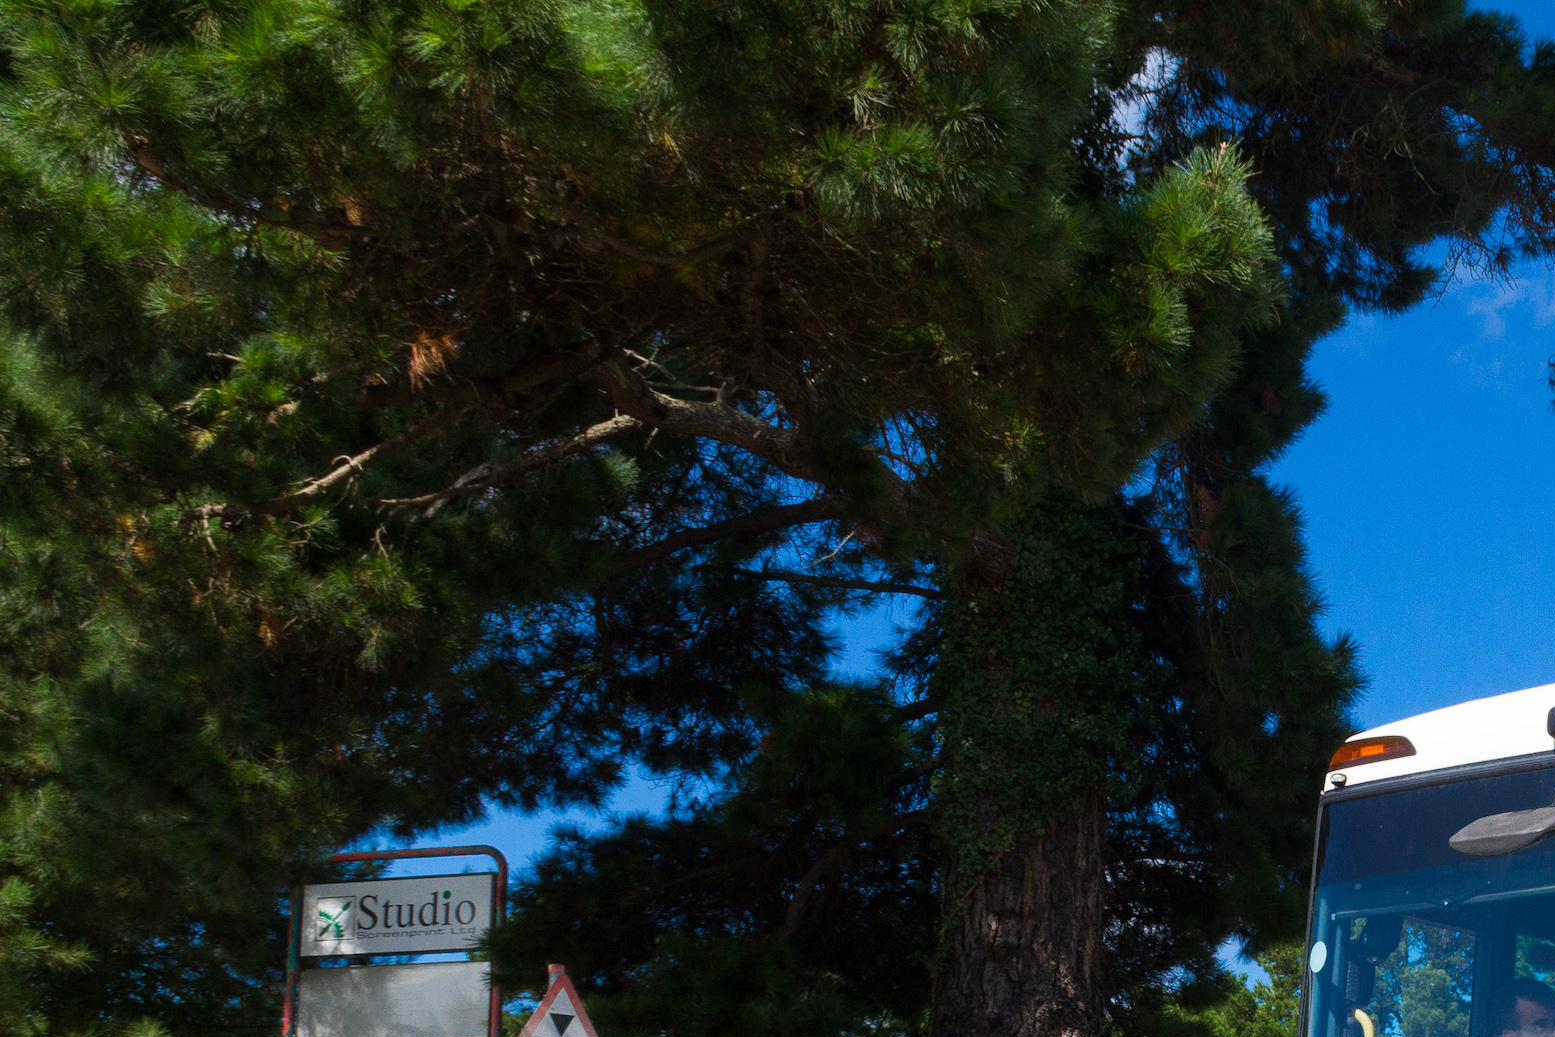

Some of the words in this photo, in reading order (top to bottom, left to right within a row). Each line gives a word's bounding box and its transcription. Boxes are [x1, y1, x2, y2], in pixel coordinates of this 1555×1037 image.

[357, 890, 476, 930] Studio
[356, 928, 445, 940] Screenprint
[451, 926, 476, 935] Ltd
